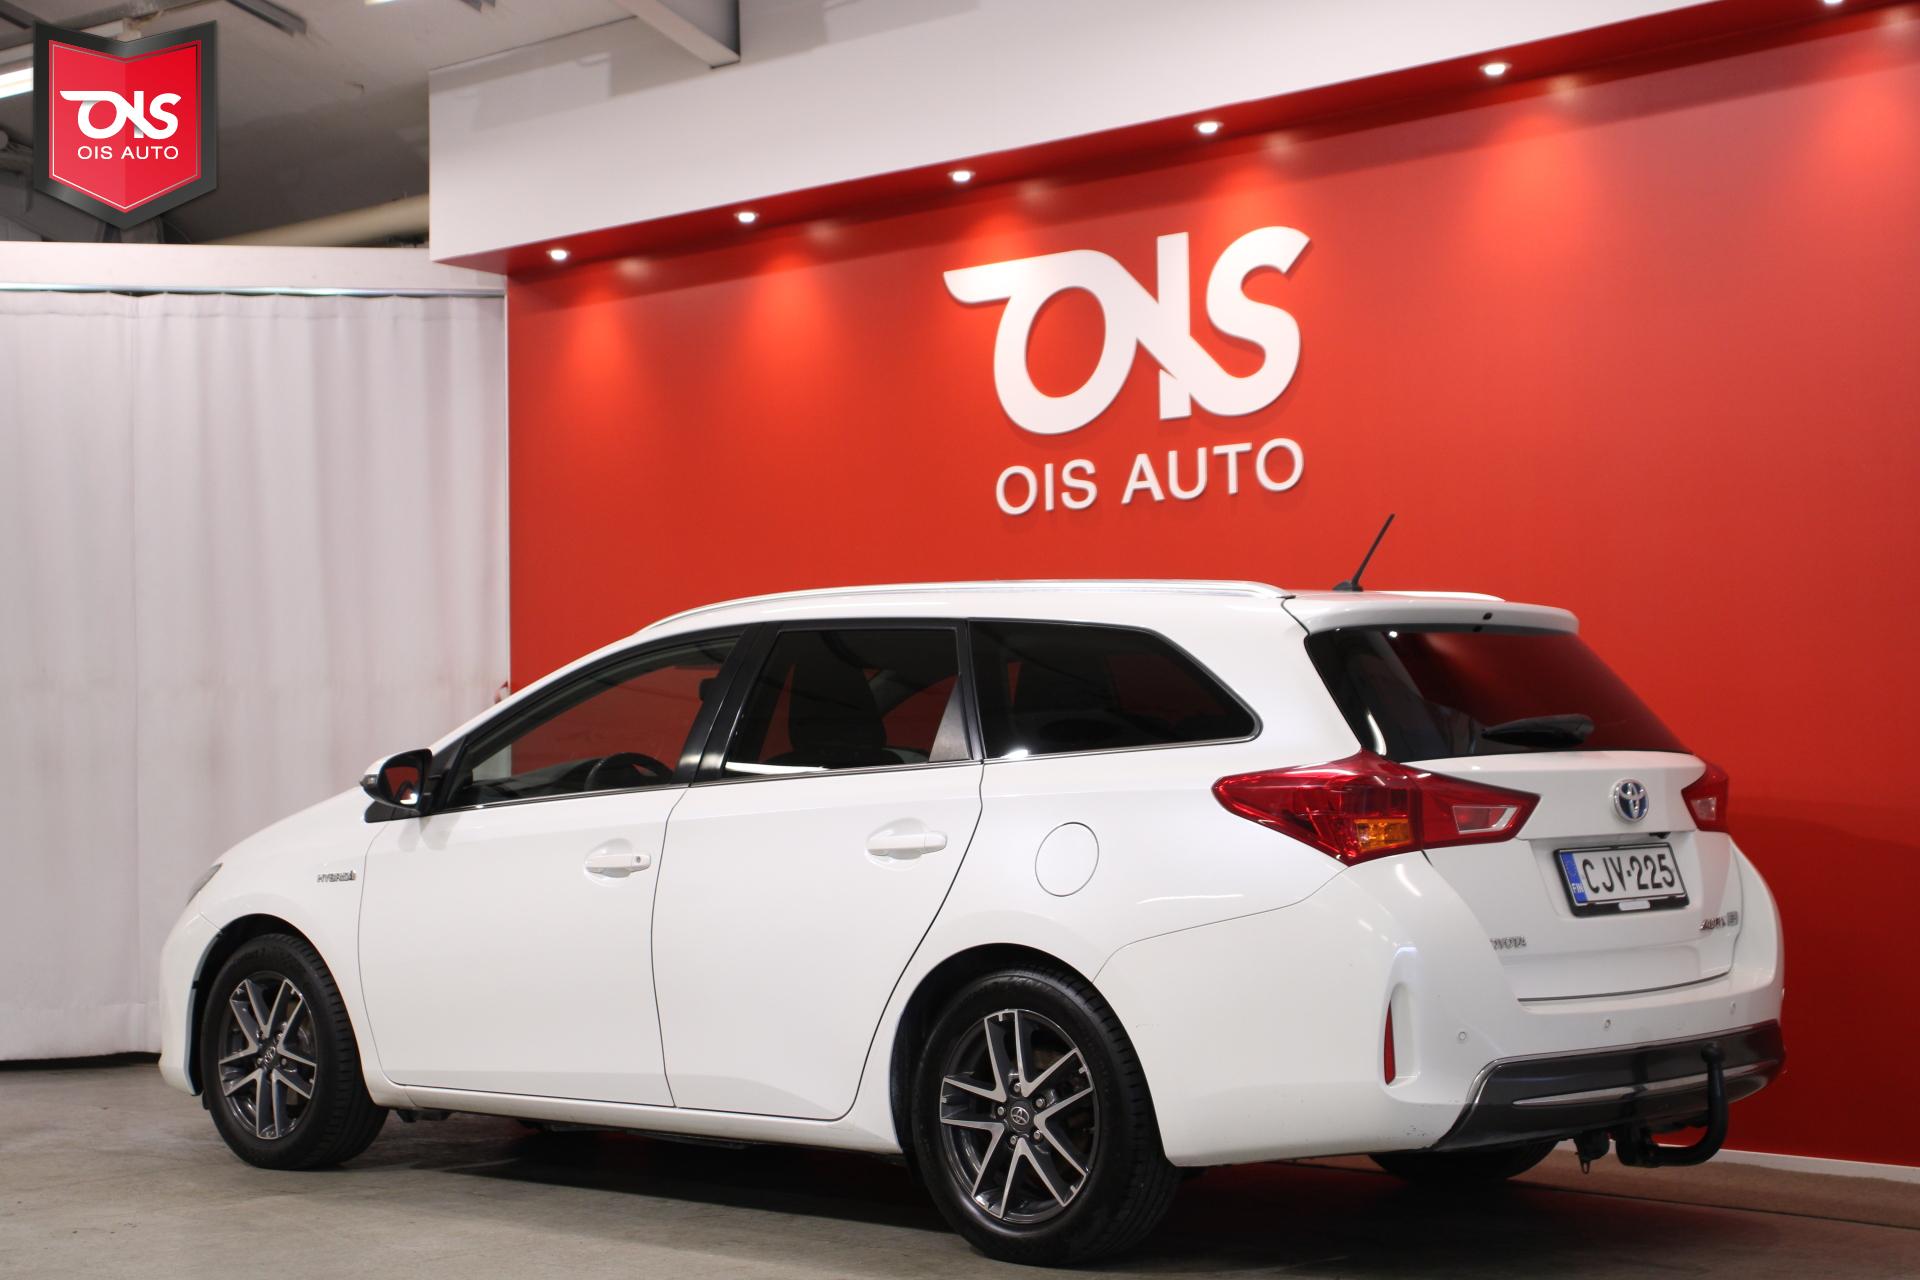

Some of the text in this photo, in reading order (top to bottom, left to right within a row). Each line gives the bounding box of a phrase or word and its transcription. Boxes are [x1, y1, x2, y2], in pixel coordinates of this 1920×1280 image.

[995, 438, 1304, 515] OIS AUTO
[1582, 853, 1675, 893] CJV-225
